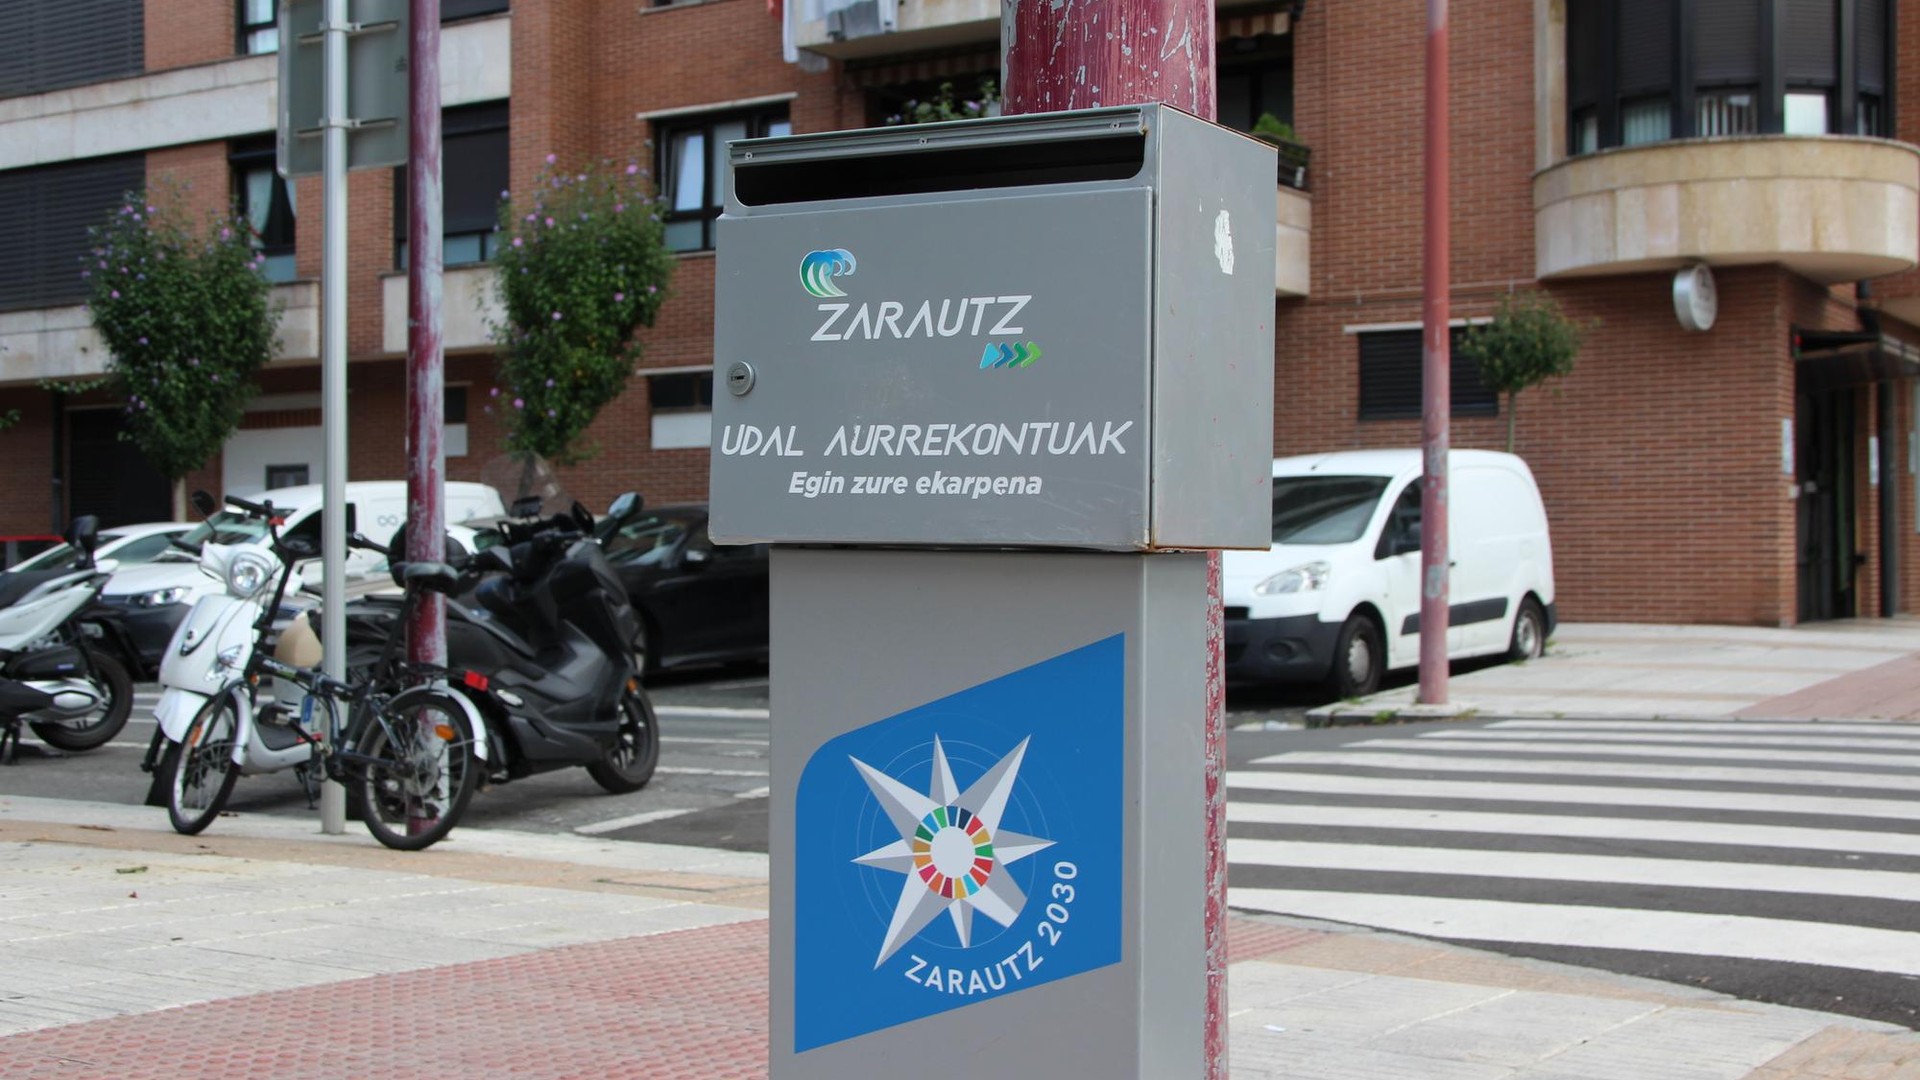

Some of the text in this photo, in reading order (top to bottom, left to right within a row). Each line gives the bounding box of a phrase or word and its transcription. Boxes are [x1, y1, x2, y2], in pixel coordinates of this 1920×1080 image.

[810, 295, 1033, 341] ZARAUTZ
[721, 420, 1134, 457] UDAL AURREKONTUAK
[788, 470, 1043, 499] Egin zure ekarpena
[904, 861, 1078, 995] ZARAUTZ 2030
